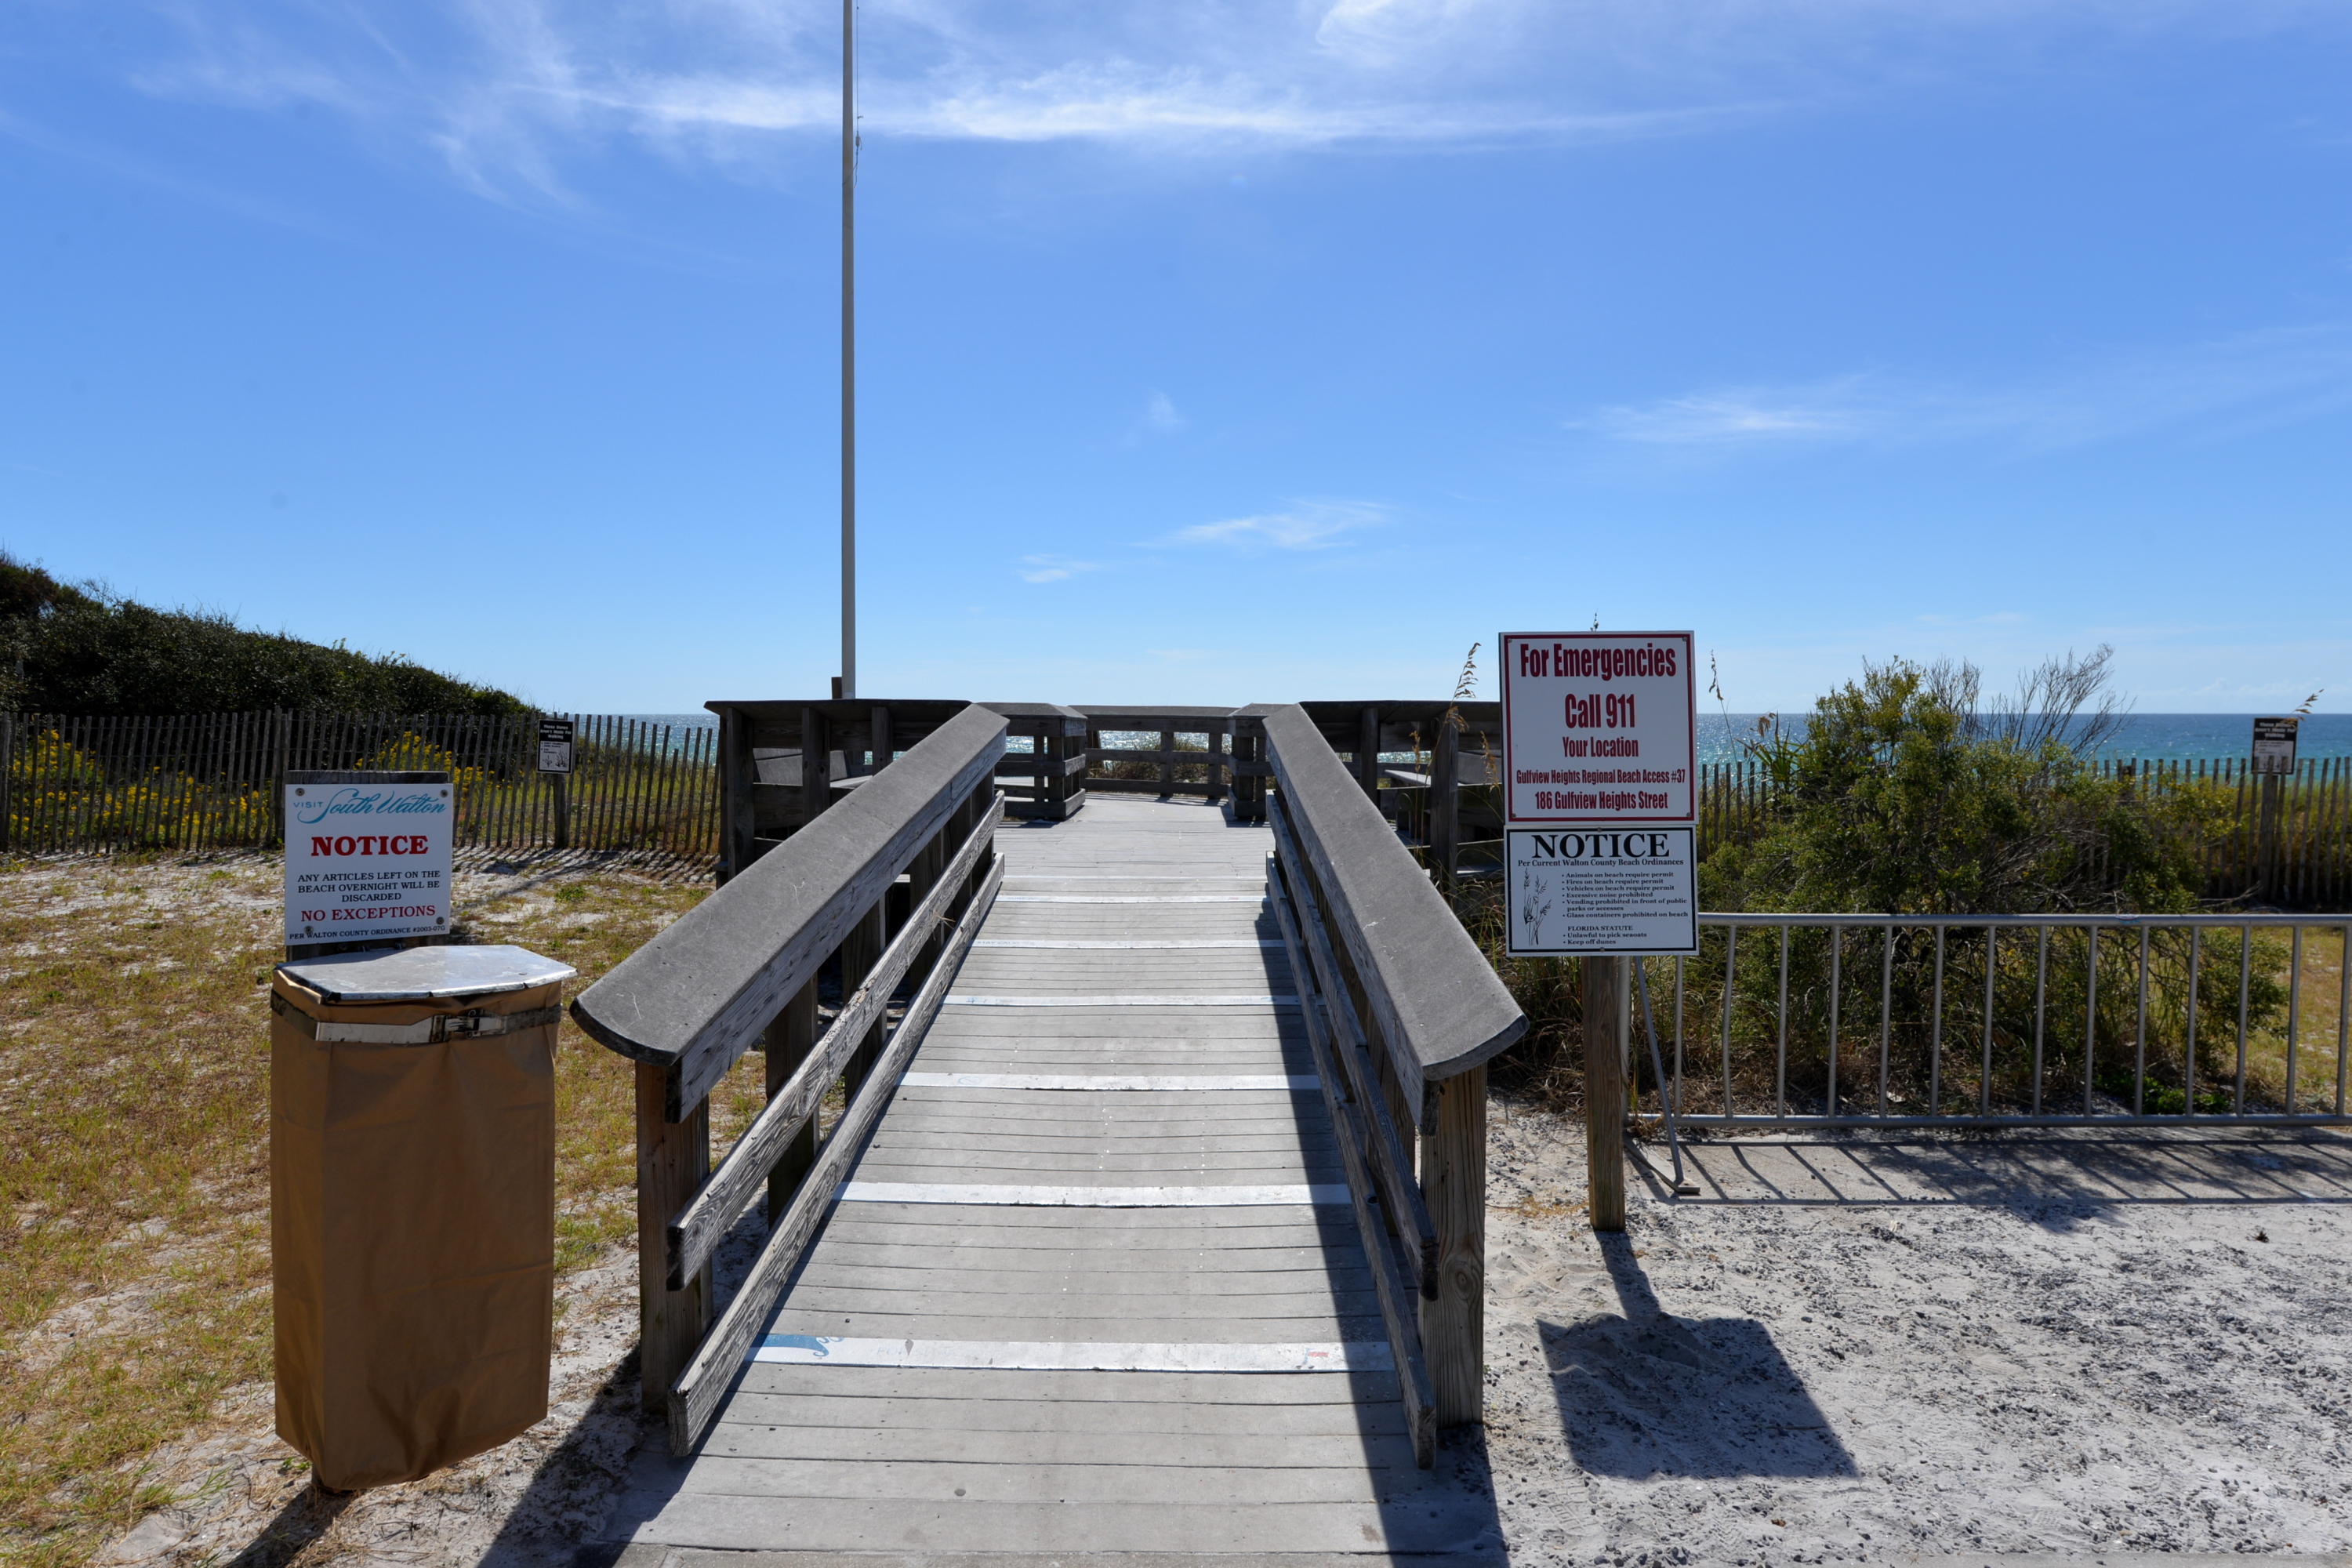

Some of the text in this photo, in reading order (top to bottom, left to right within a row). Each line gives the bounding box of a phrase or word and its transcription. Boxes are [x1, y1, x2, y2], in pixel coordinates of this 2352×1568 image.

[1520, 643, 1676, 681] For Emergencies
[1565, 694, 1635, 728] Call 911
[1563, 737, 1639, 757] Your Location
[1517, 770, 1685, 785] Gulfview Heights Regional Beach Access #37
[297, 788, 381, 823] South
[376, 790, 445, 814] Walton
[1535, 791, 1668, 811] 186 Gulfview Heights Street
[311, 835, 428, 856] NOTICE
[1531, 833, 1670, 858] NOTICE
[323, 873, 374, 881] ARTICLES
[298, 884, 336, 893] BEACH
[339, 882, 397, 891] OVERNIGHT
[342, 893, 401, 902] DISCARDED
[301, 906, 435, 921] NO EXCEPTIONS
